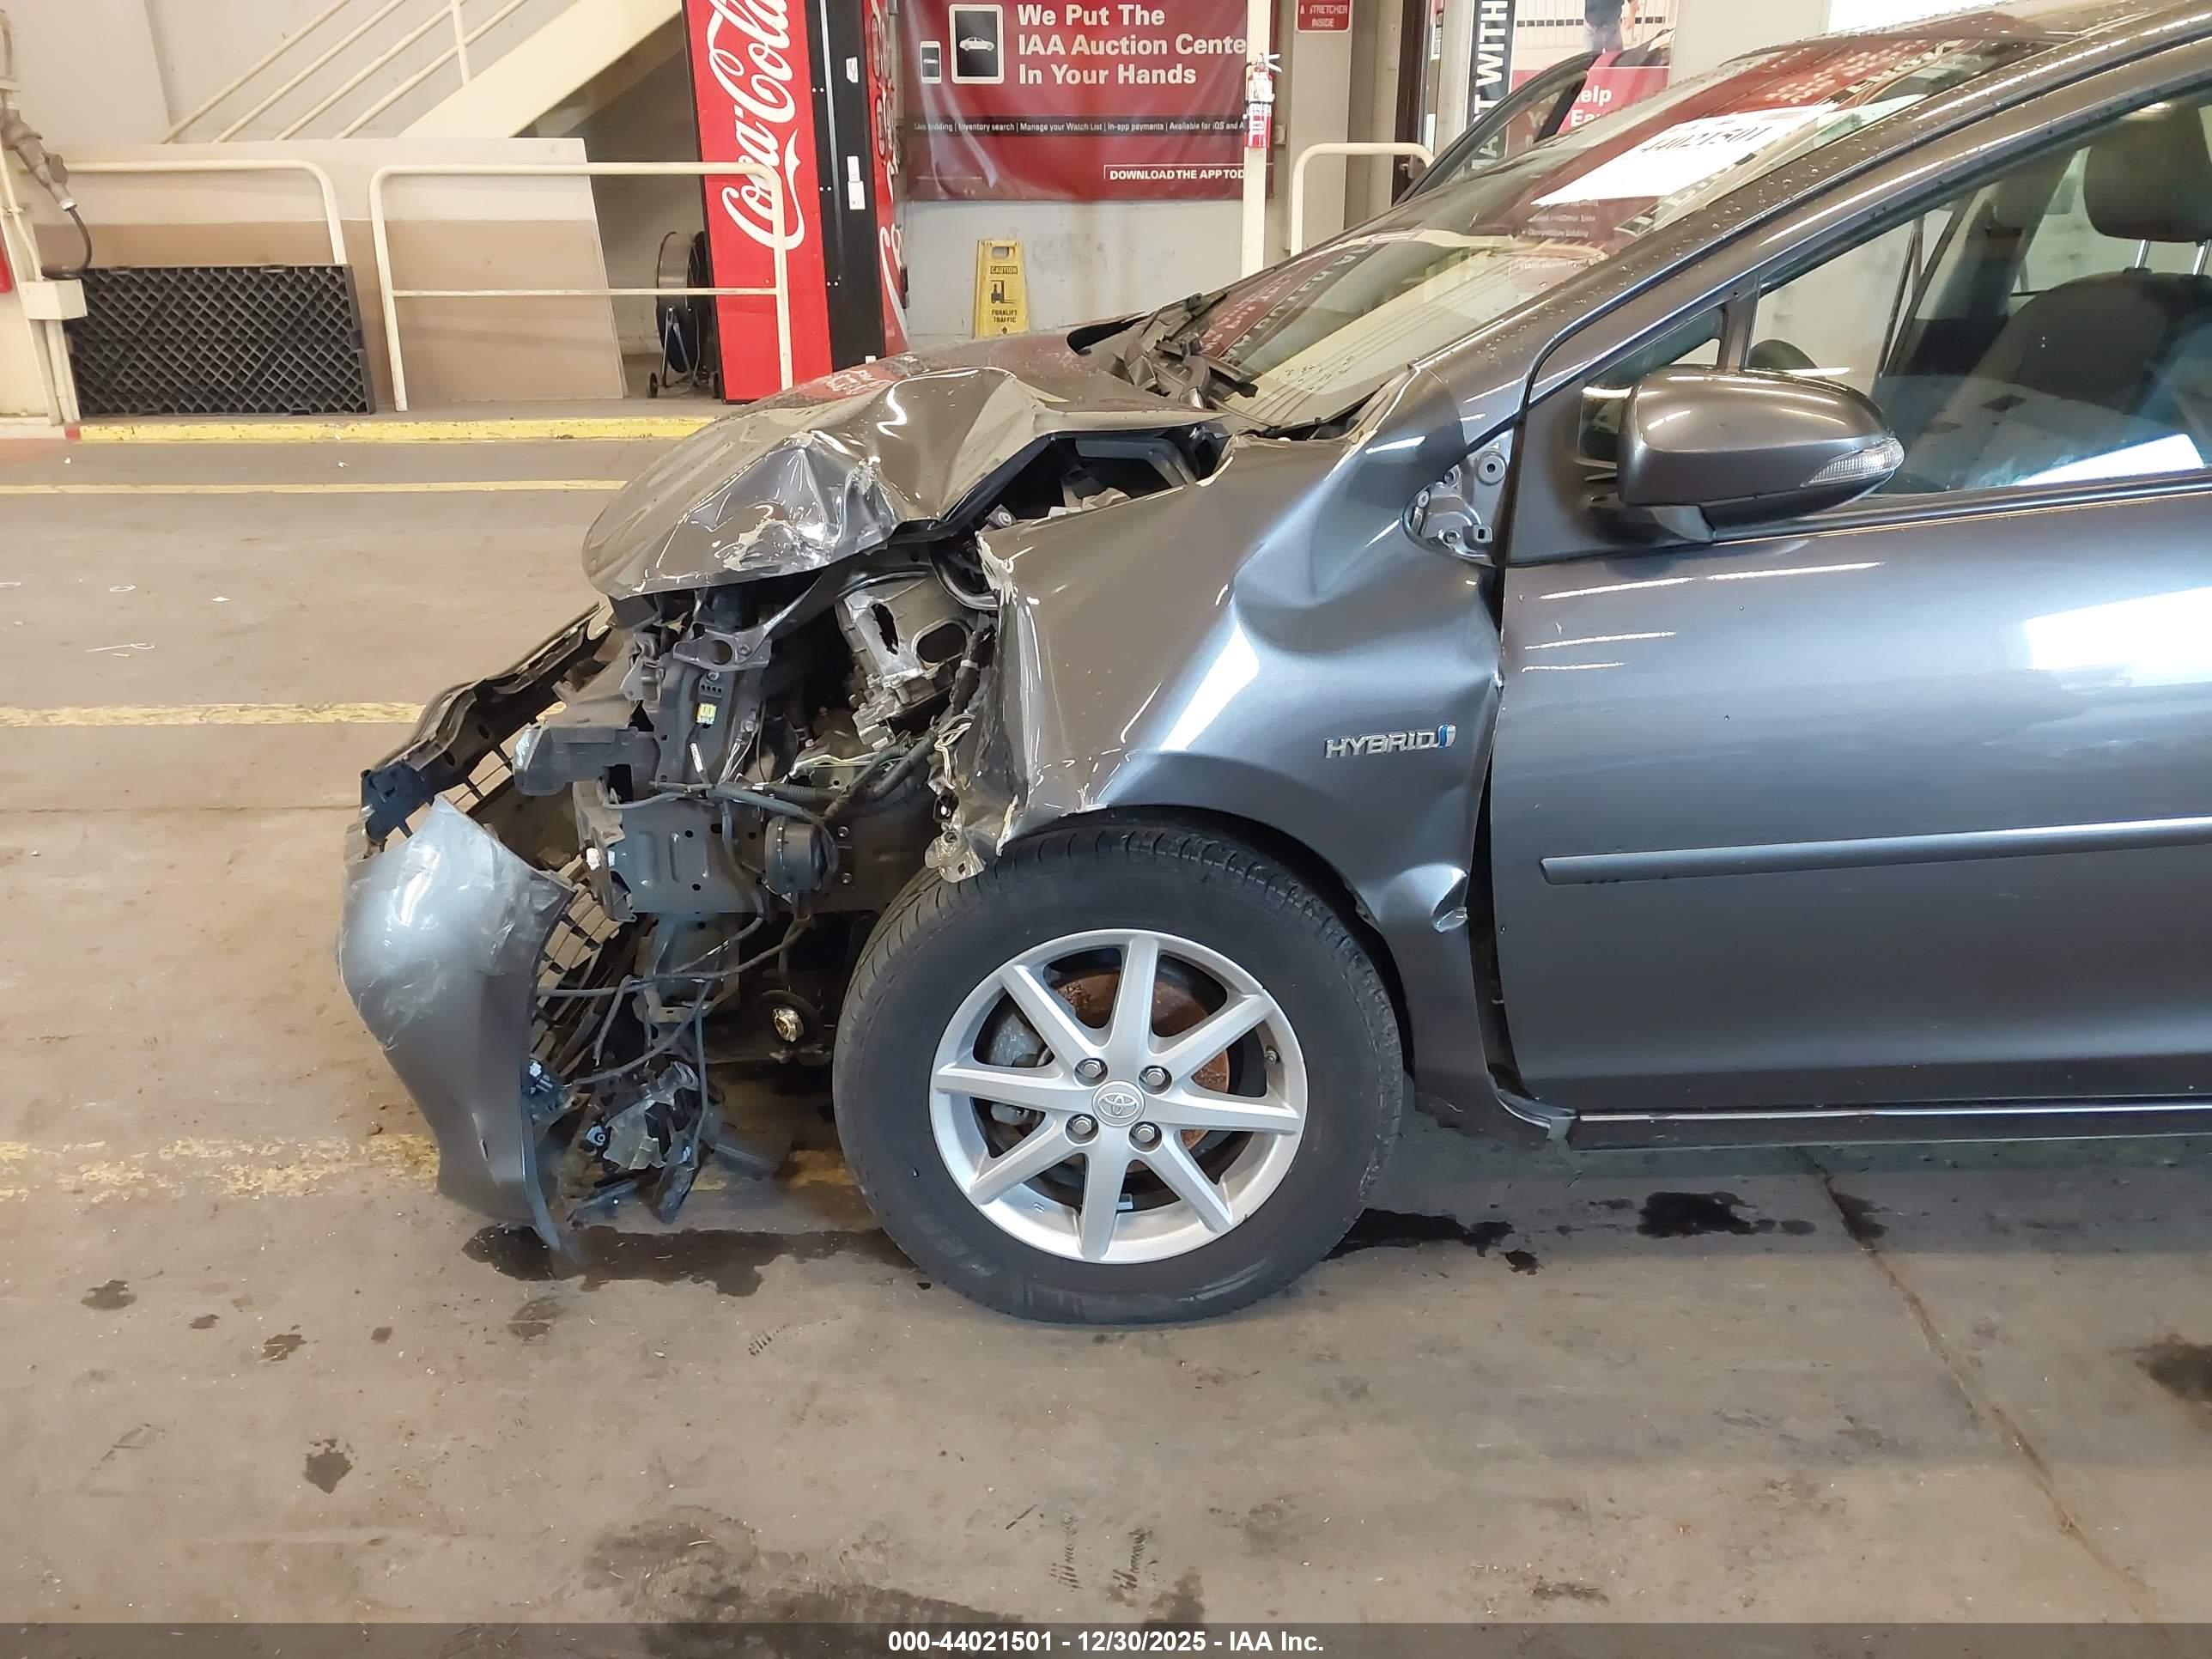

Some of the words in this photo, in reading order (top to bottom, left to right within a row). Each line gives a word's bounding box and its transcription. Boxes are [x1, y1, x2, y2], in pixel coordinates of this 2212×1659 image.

[1018, 4, 1056, 26] We
[1066, 4, 1109, 26] Put
[1117, 4, 1165, 26] The
[1310, 4, 1348, 15] STRETCHER
[1311, 17, 1335, 27] INSIDE
[1018, 34, 1066, 55] IAA
[1071, 34, 1168, 55] Auction
[1475, 0, 1509, 88] WITH
[1019, 64, 1042, 84] In
[1051, 64, 1109, 84] Your
[1117, 63, 1196, 84] Hands
[1573, 85, 1612, 106] elp
[957, 123, 991, 132] Inventory
[992, 123, 1015, 131] search
[1020, 123, 1048, 132] Manage
[1066, 122, 1088, 131] Watch
[1108, 122, 1130, 131] In-app
[1132, 123, 1164, 131] payments
[1170, 122, 1200, 131] Available
[1109, 170, 1175, 179] DOWNLOAD
[1176, 170, 1197, 179] THE
[1199, 170, 1223, 179] APP
[1324, 731, 1439, 758] HYBRID
